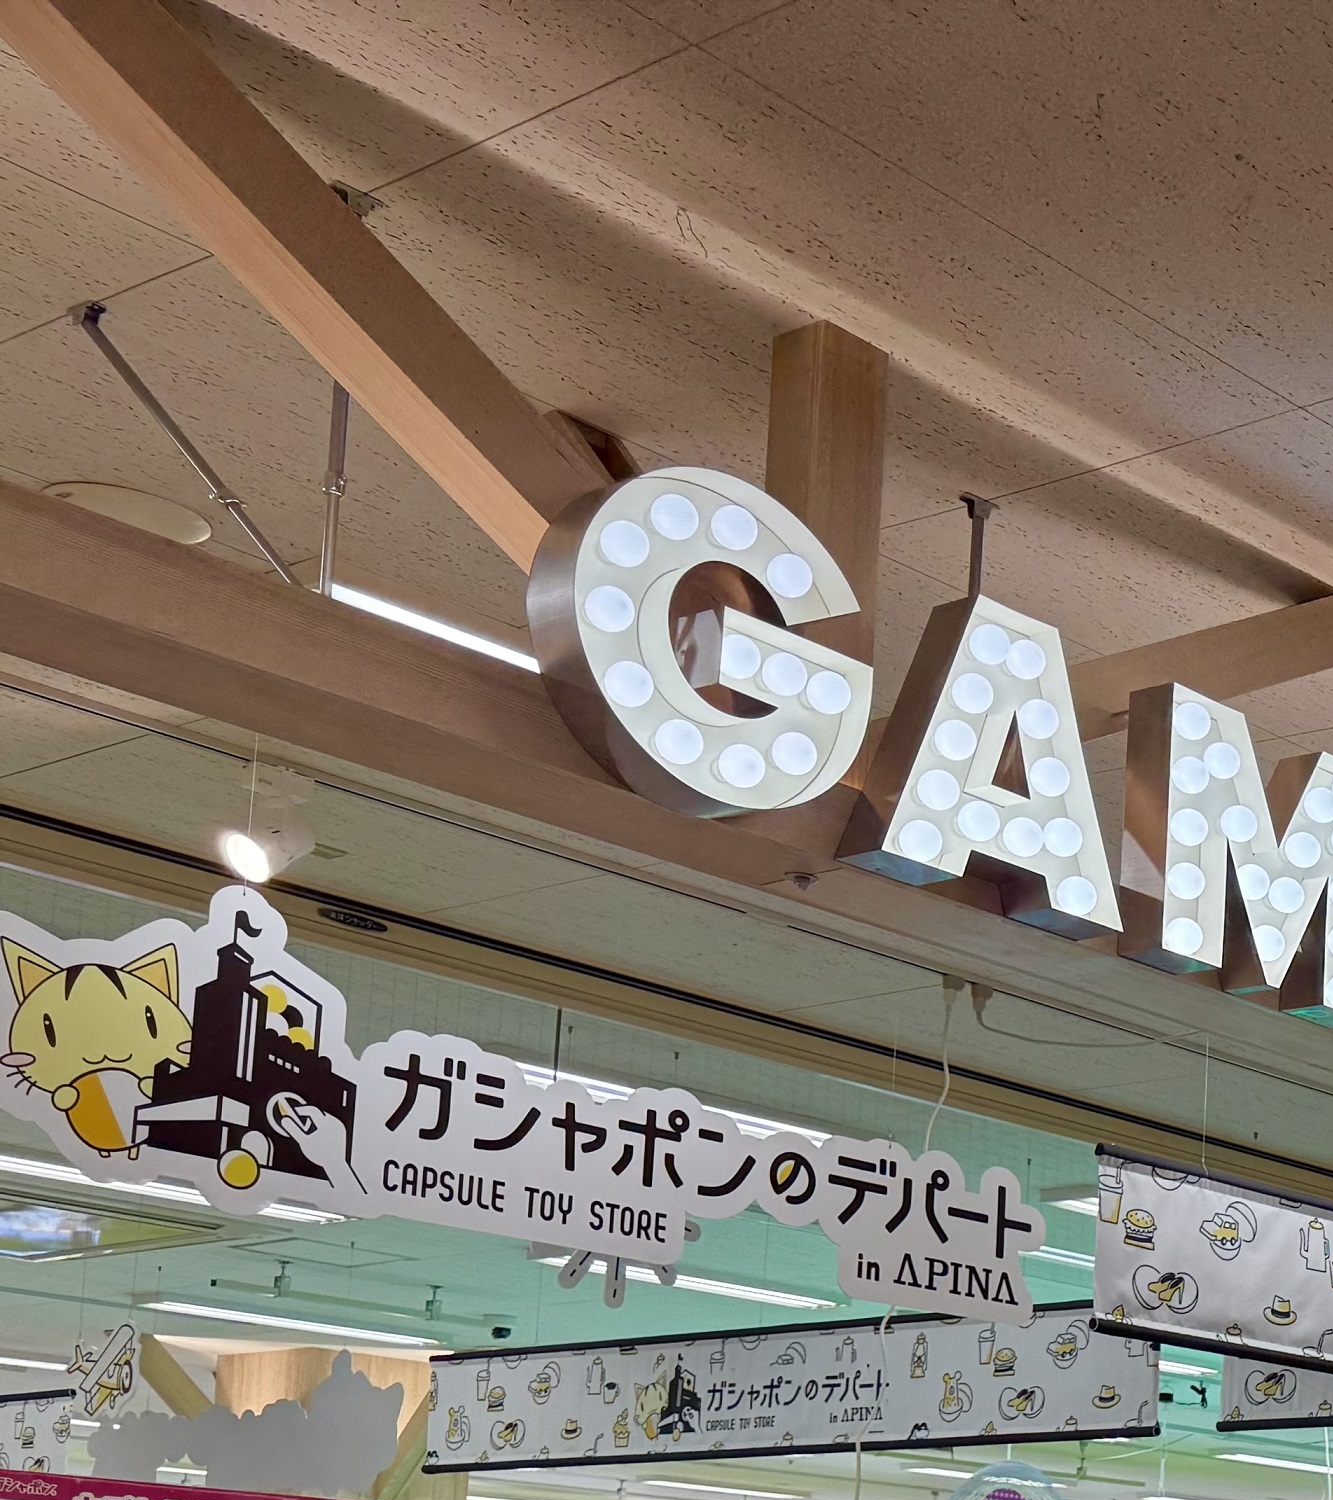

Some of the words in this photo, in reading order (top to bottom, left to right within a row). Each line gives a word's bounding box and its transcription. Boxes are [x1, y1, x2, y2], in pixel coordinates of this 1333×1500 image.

[382, 1053, 1031, 1259] ガシャポンのデパート
[382, 1160, 505, 1213] CAPSULE
[524, 1185, 573, 1225] TOY
[590, 1200, 668, 1244] STORE
[857, 1253, 881, 1283] in
[706, 1370, 889, 1411] ガシャポンのデパート
[706, 1418, 736, 1431] CAPSULE
[739, 1417, 751, 1429] TOY
[753, 1415, 775, 1428] STORE
[829, 1409, 838, 1424] in
